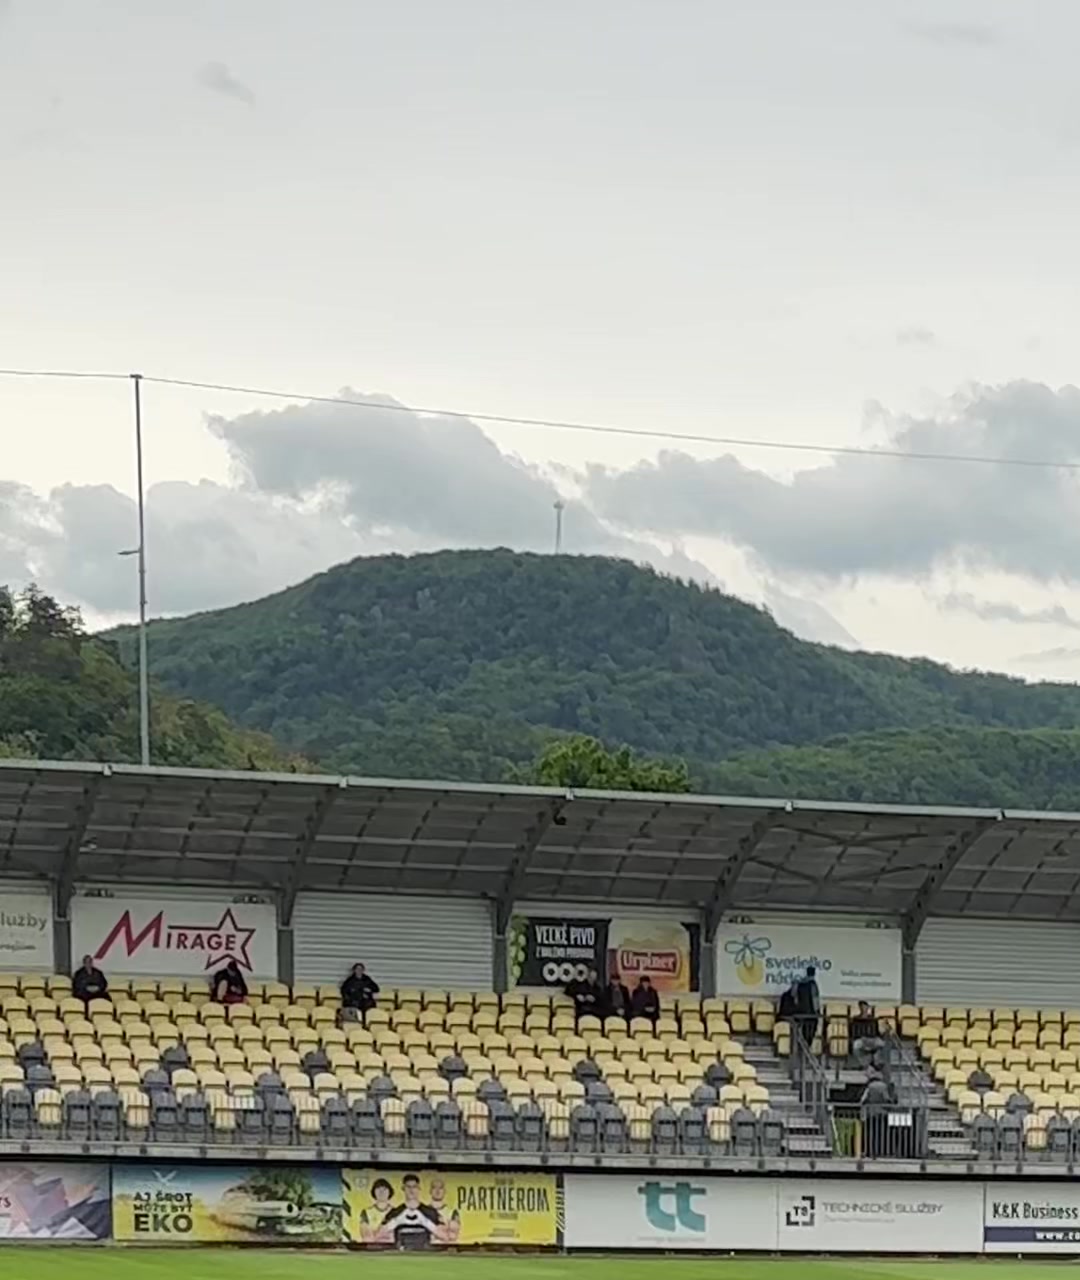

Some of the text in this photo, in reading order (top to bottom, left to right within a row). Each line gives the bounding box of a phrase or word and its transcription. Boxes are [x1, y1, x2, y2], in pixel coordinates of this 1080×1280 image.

[93, 909, 236, 960] MIRAGE
[569, 926, 595, 945] PIVO
[457, 1187, 550, 1212] PARTNEROM
[992, 1203, 1019, 1218] K&K
[1022, 1203, 1078, 1219] Business
[134, 1213, 193, 1233] EKO
